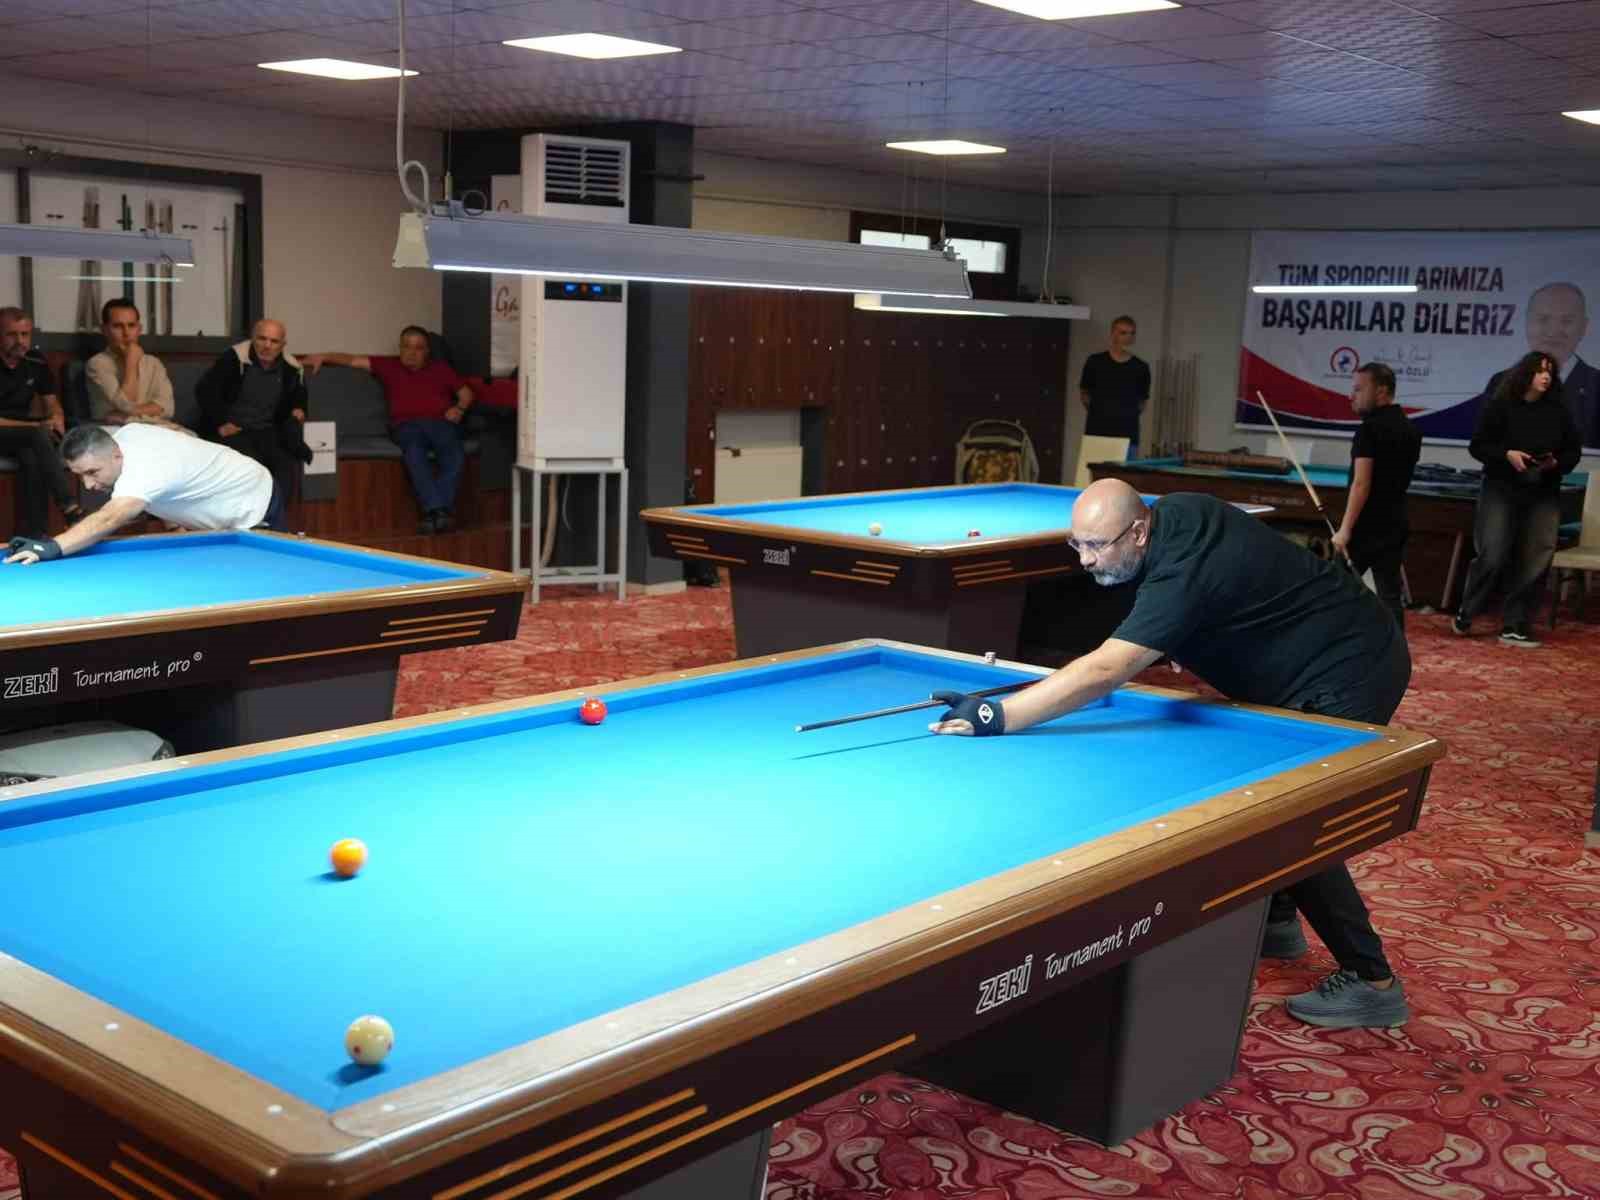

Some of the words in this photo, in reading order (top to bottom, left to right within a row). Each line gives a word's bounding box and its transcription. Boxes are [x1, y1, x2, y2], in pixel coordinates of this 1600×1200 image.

[1279, 264, 1318, 286] TÜM
[1324, 265, 1504, 292] SPORCULARIMIZA
[1261, 299, 1406, 335] BAŞARILAR
[73, 661, 161, 687] Tournament
[1044, 924, 1124, 980] Tournament
